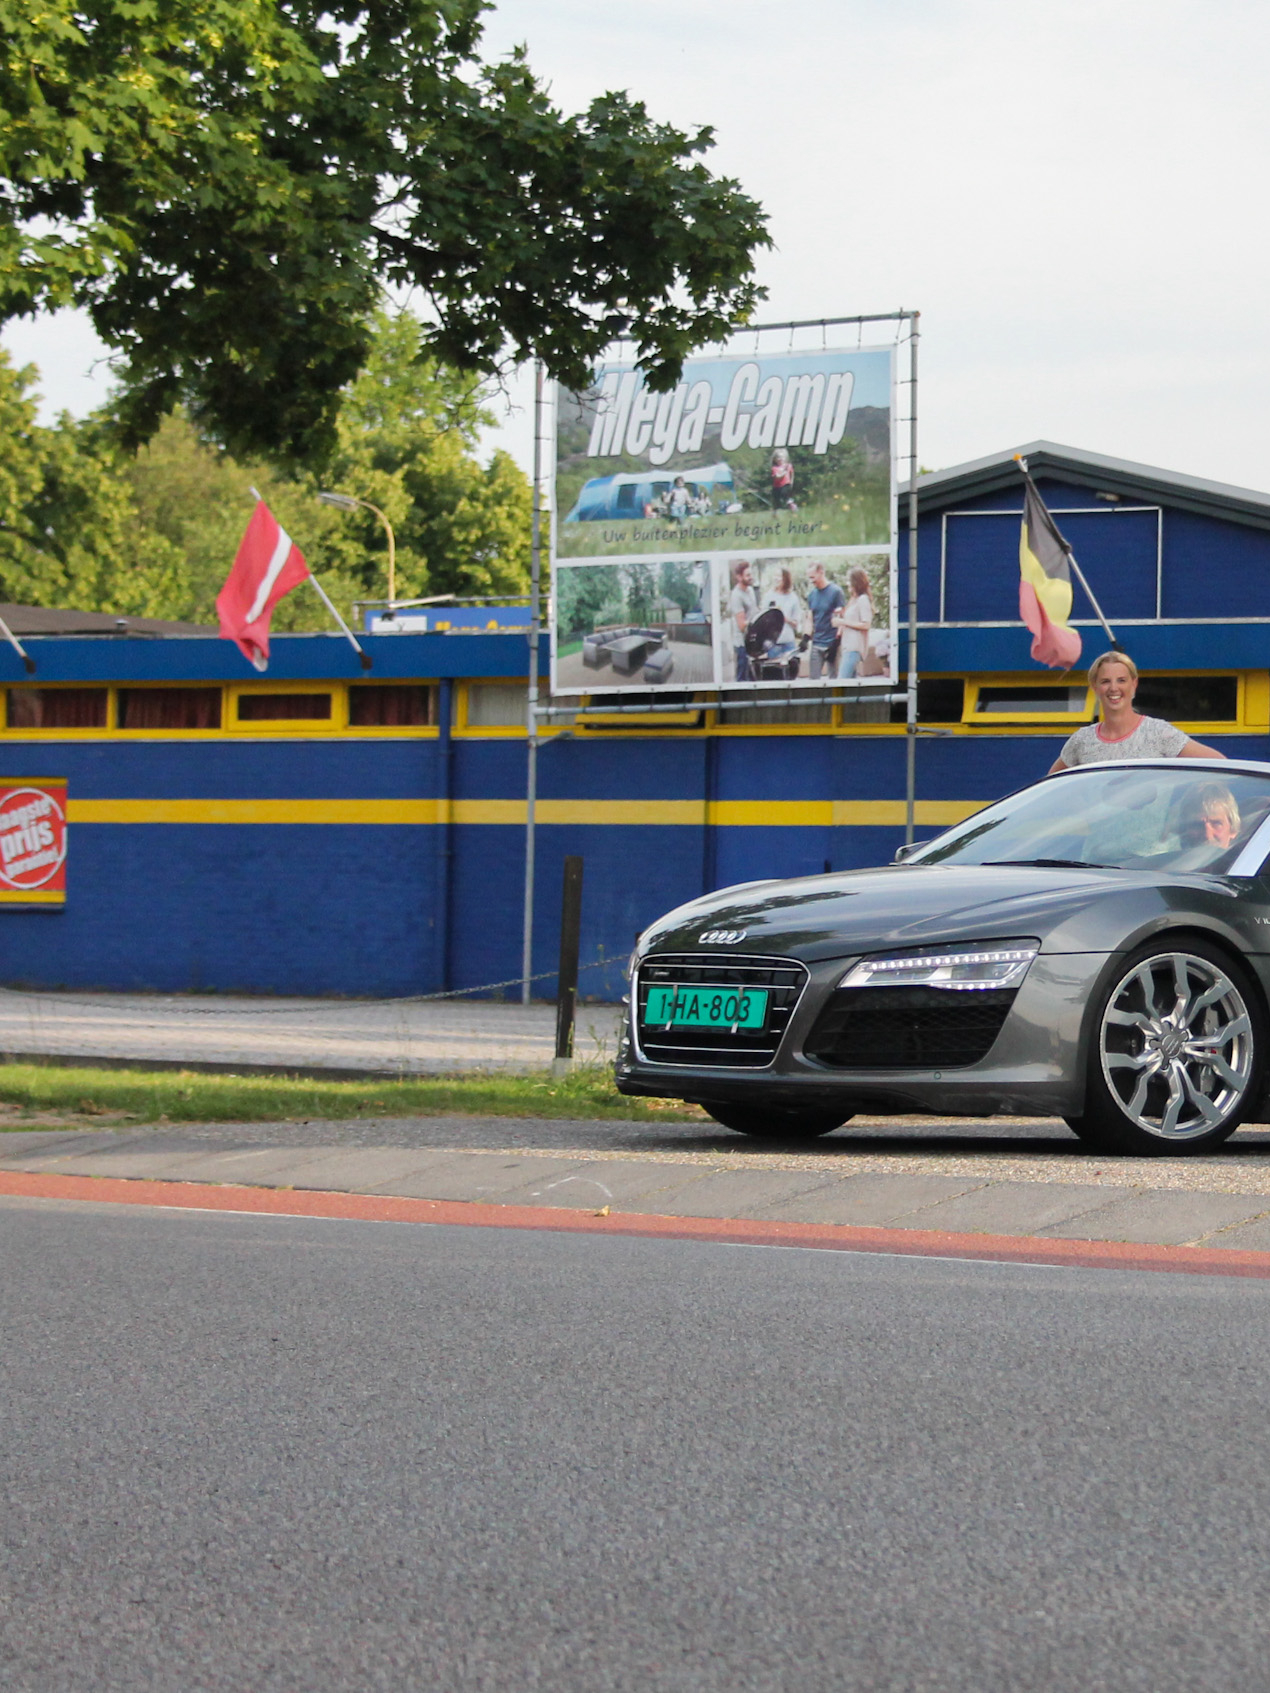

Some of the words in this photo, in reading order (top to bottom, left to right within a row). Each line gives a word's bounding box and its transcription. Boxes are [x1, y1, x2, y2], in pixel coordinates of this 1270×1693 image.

[587, 362, 854, 465] Mega-Camp
[603, 529, 626, 543] Uw
[633, 525, 728, 544] buitenplezier
[735, 521, 781, 541] begint
[0, 798, 52, 832] aagste
[1, 820, 54, 864] prijs
[660, 993, 751, 1022] 1-HA-803
